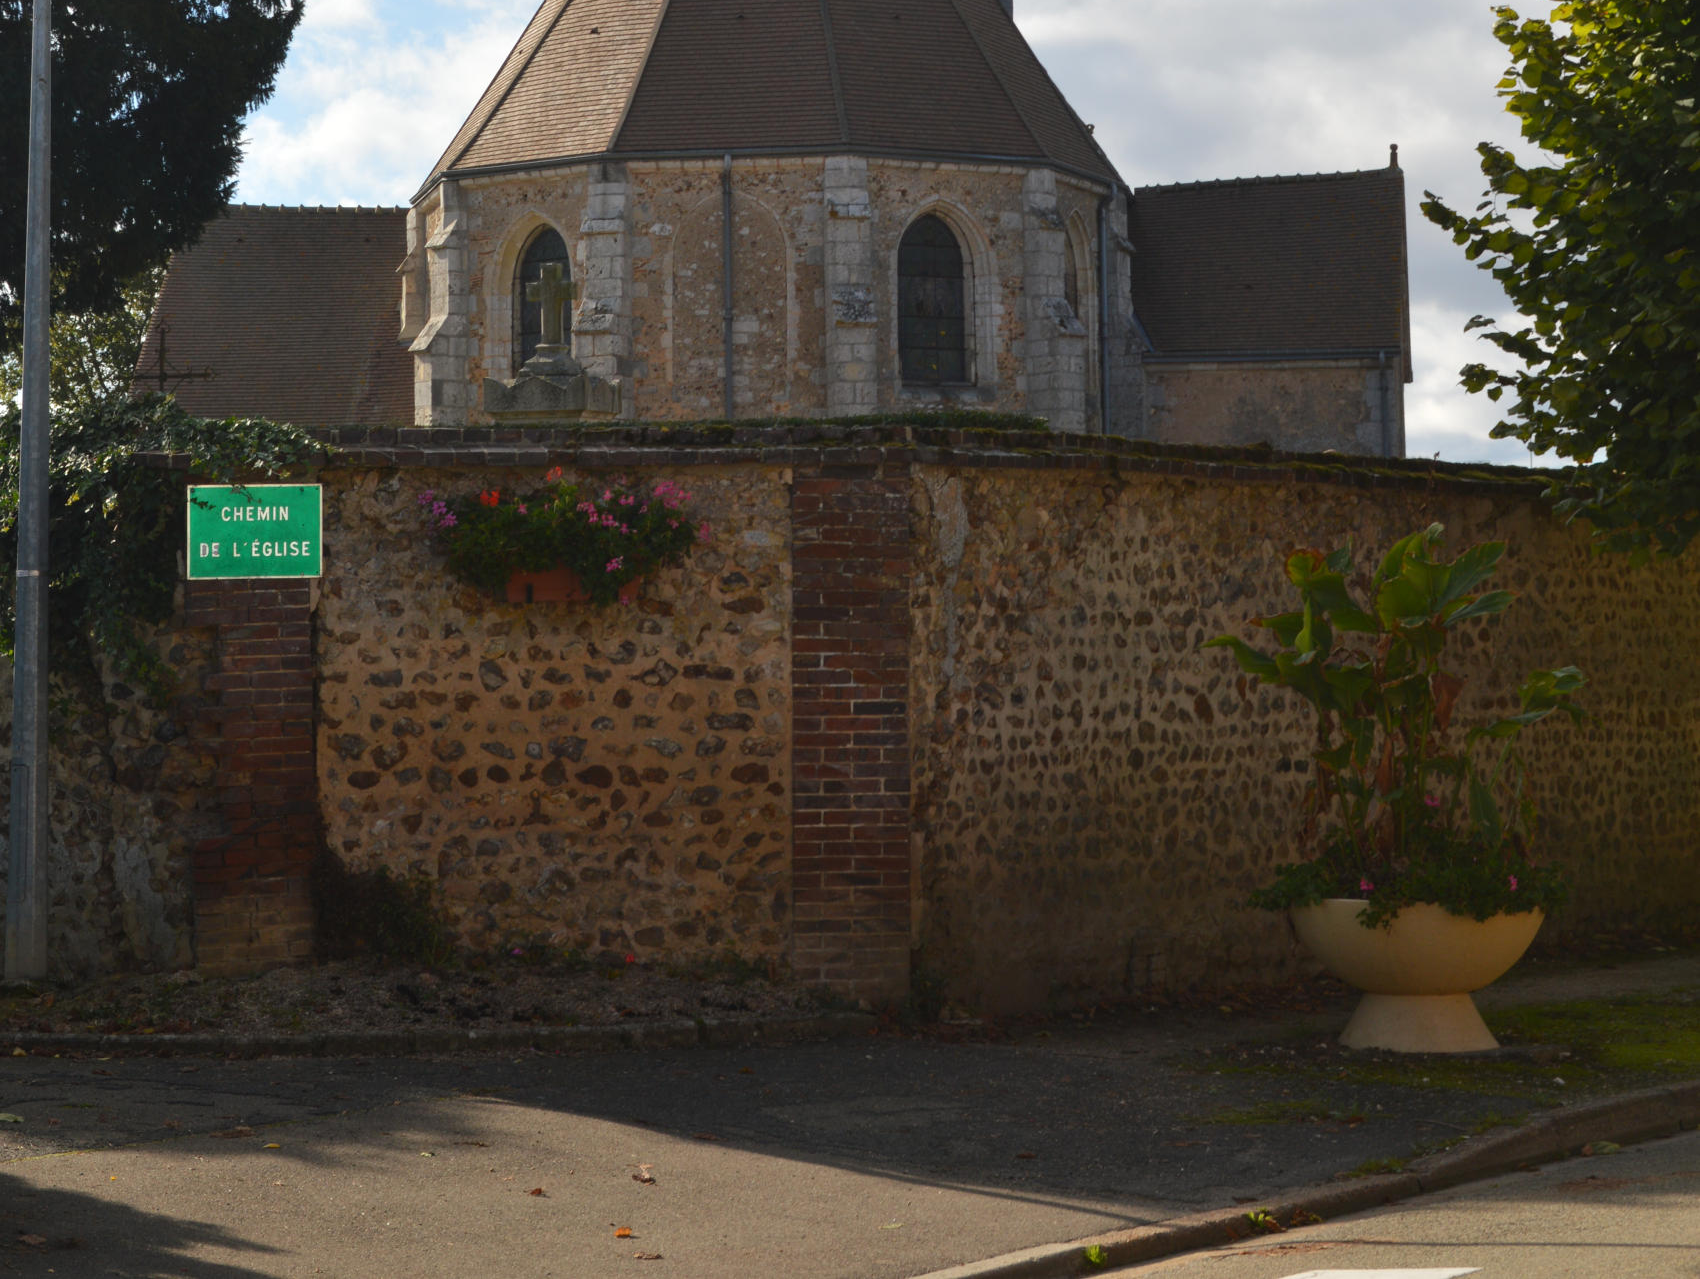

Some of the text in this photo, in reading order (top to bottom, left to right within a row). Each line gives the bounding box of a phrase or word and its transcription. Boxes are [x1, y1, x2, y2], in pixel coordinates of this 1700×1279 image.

[221, 506, 289, 522] CHEMIN
[199, 538, 311, 558] DE L'ÉGLISE
